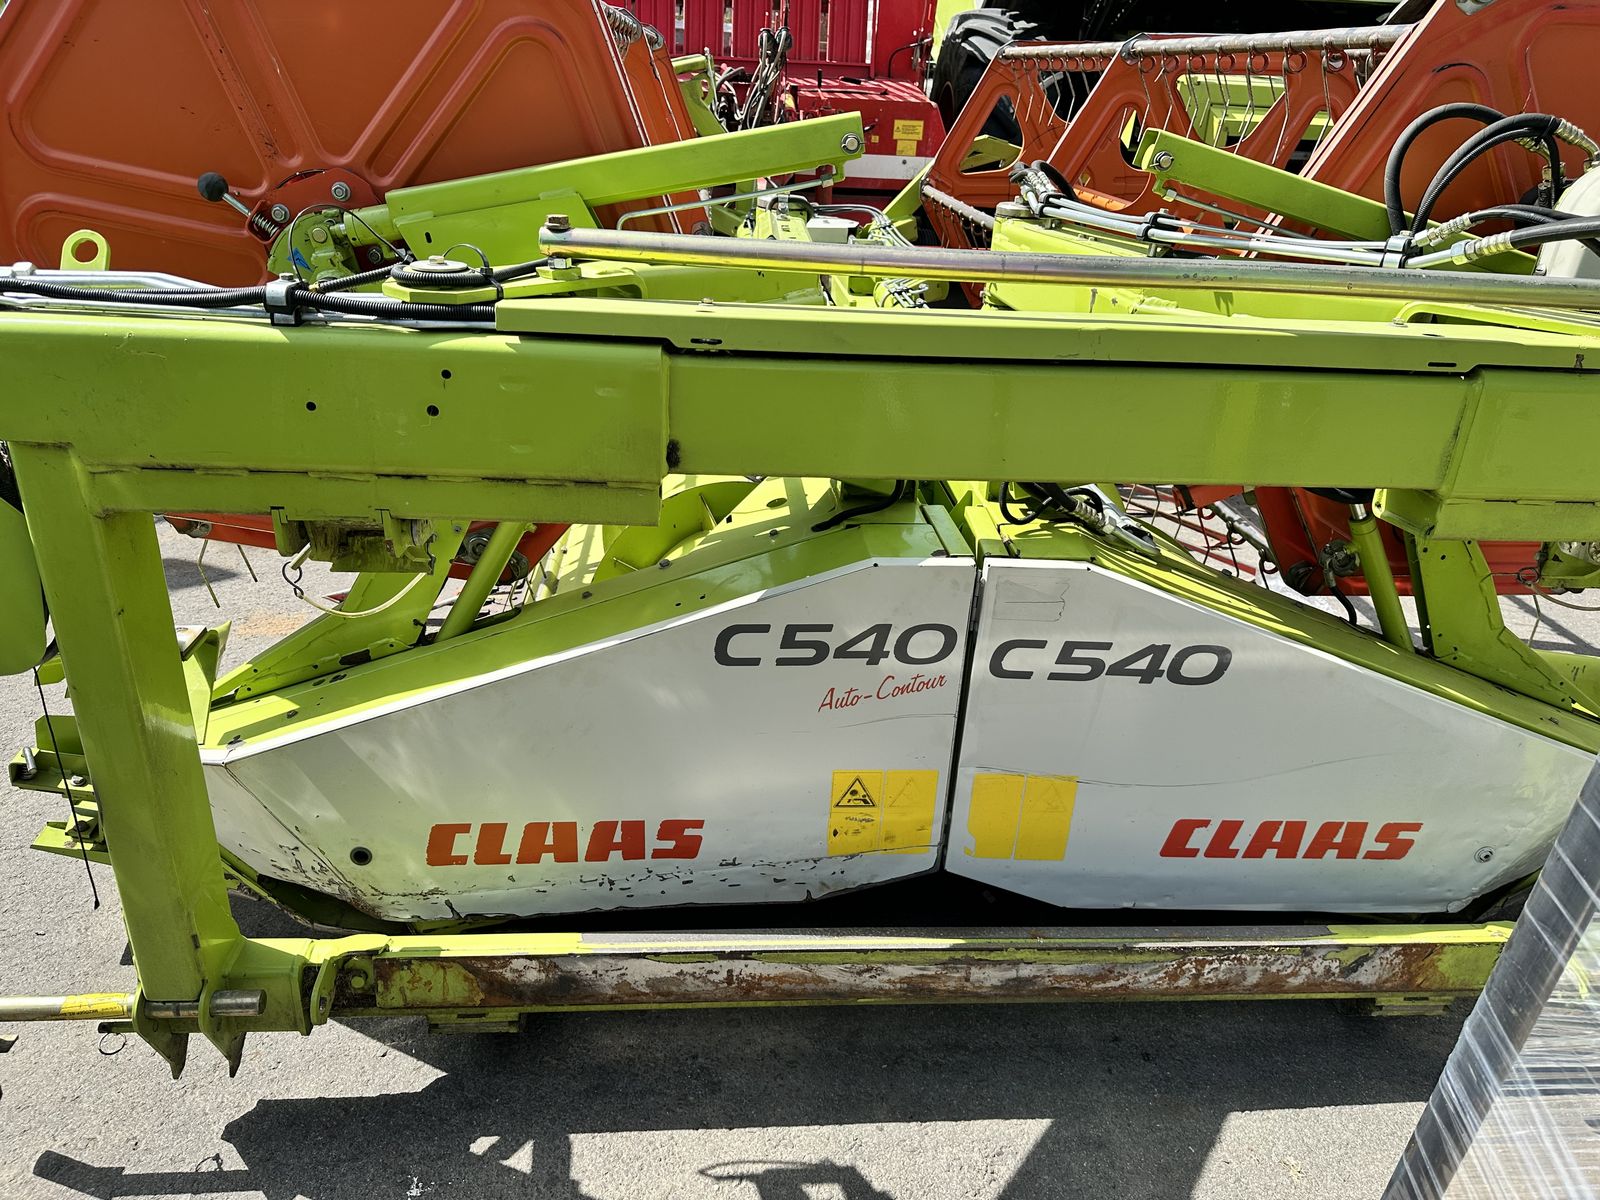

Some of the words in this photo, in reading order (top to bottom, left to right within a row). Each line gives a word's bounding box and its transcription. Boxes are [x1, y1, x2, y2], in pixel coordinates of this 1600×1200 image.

[714, 624, 958, 666] C540
[988, 639, 1233, 686] C540
[818, 673, 948, 712] Auto-Contour
[428, 820, 705, 866] CLAAS
[1160, 818, 1424, 860] CLAAS
